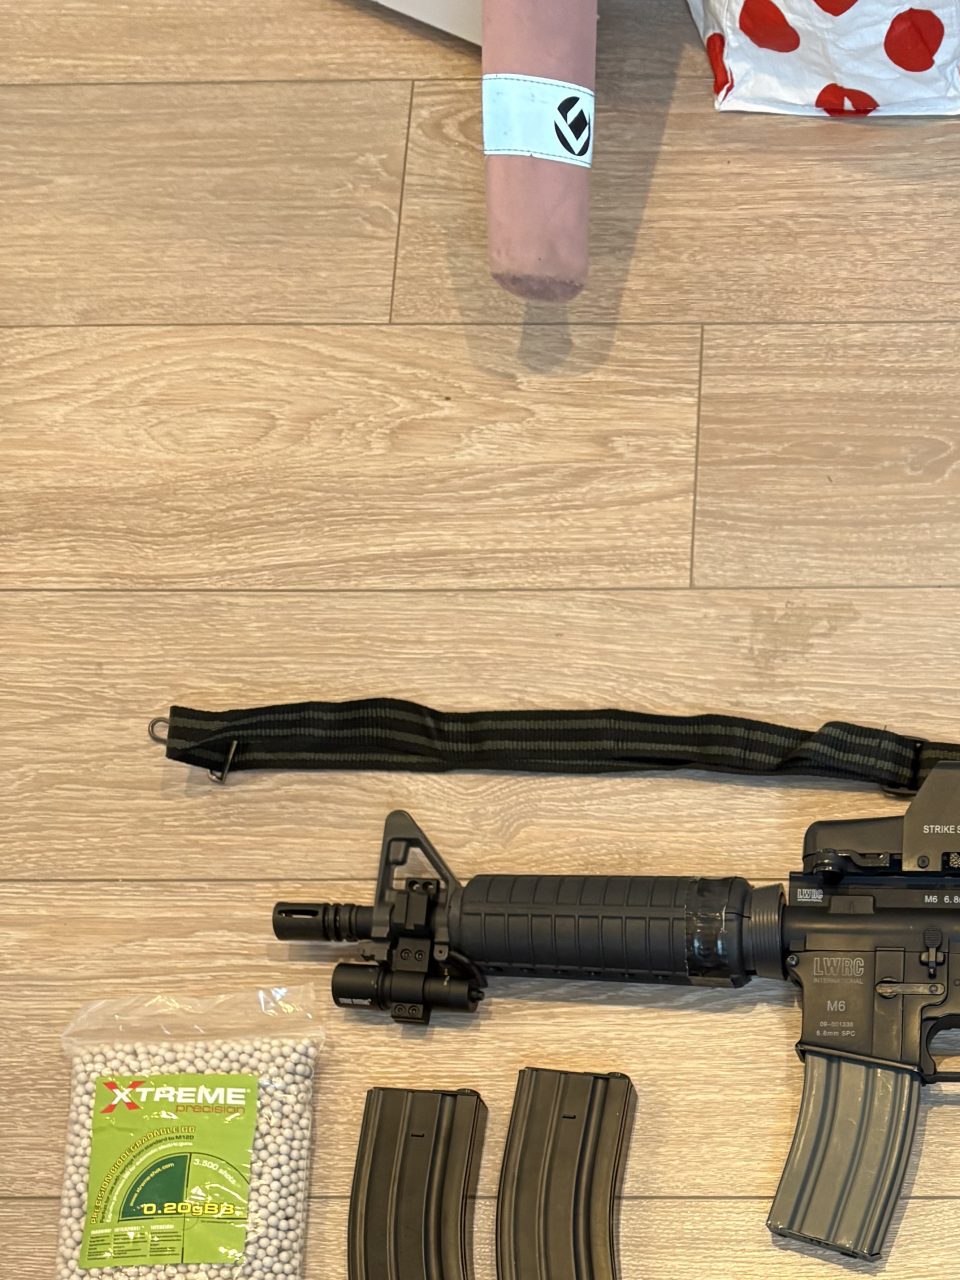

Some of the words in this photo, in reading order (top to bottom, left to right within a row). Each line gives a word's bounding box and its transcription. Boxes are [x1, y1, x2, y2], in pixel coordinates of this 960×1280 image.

[922, 824, 956, 834] STRIKE
[924, 895, 938, 903] M6
[813, 957, 865, 977] LWRC
[827, 1000, 846, 1012] M6
[100, 1080, 246, 1114] XTREME
[175, 1104, 246, 1115] precision
[193, 1158, 218, 1171] 3.500
